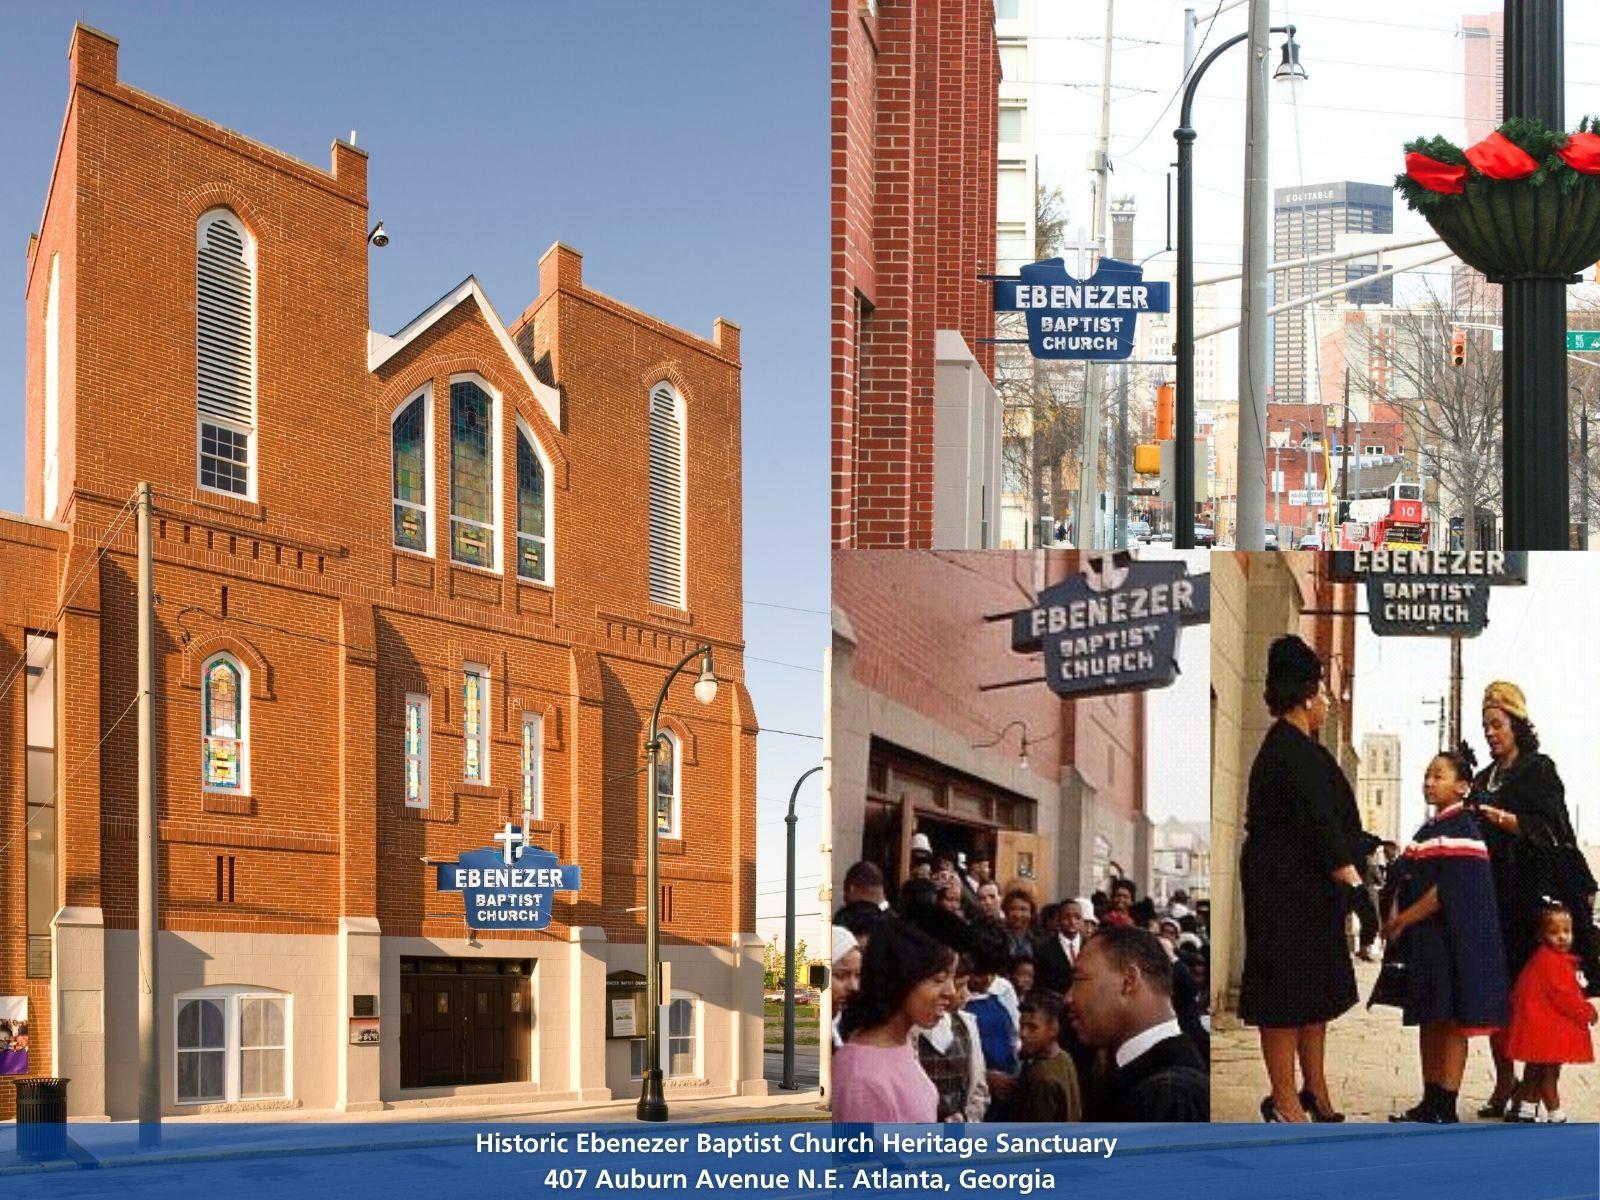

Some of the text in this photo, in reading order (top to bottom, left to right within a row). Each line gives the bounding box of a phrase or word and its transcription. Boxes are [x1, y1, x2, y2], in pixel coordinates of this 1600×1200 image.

[1015, 285, 1149, 309] EBENEZER
[1041, 316, 1123, 333] BAPTIST
[1042, 336, 1118, 351] CHURCH
[1401, 506, 1415, 517] 10
[1353, 551, 1505, 574] EBENEZER
[1383, 582, 1476, 600] BAPTIST
[1031, 580, 1193, 636] EBENEZER
[1385, 603, 1470, 622] CHURCH
[1060, 625, 1160, 657] BAPTIST
[1061, 651, 1153, 680] CHURCH
[455, 869, 563, 888] EBENEZER
[476, 894, 543, 907] BAPTIST
[477, 910, 539, 922] CHURCH
